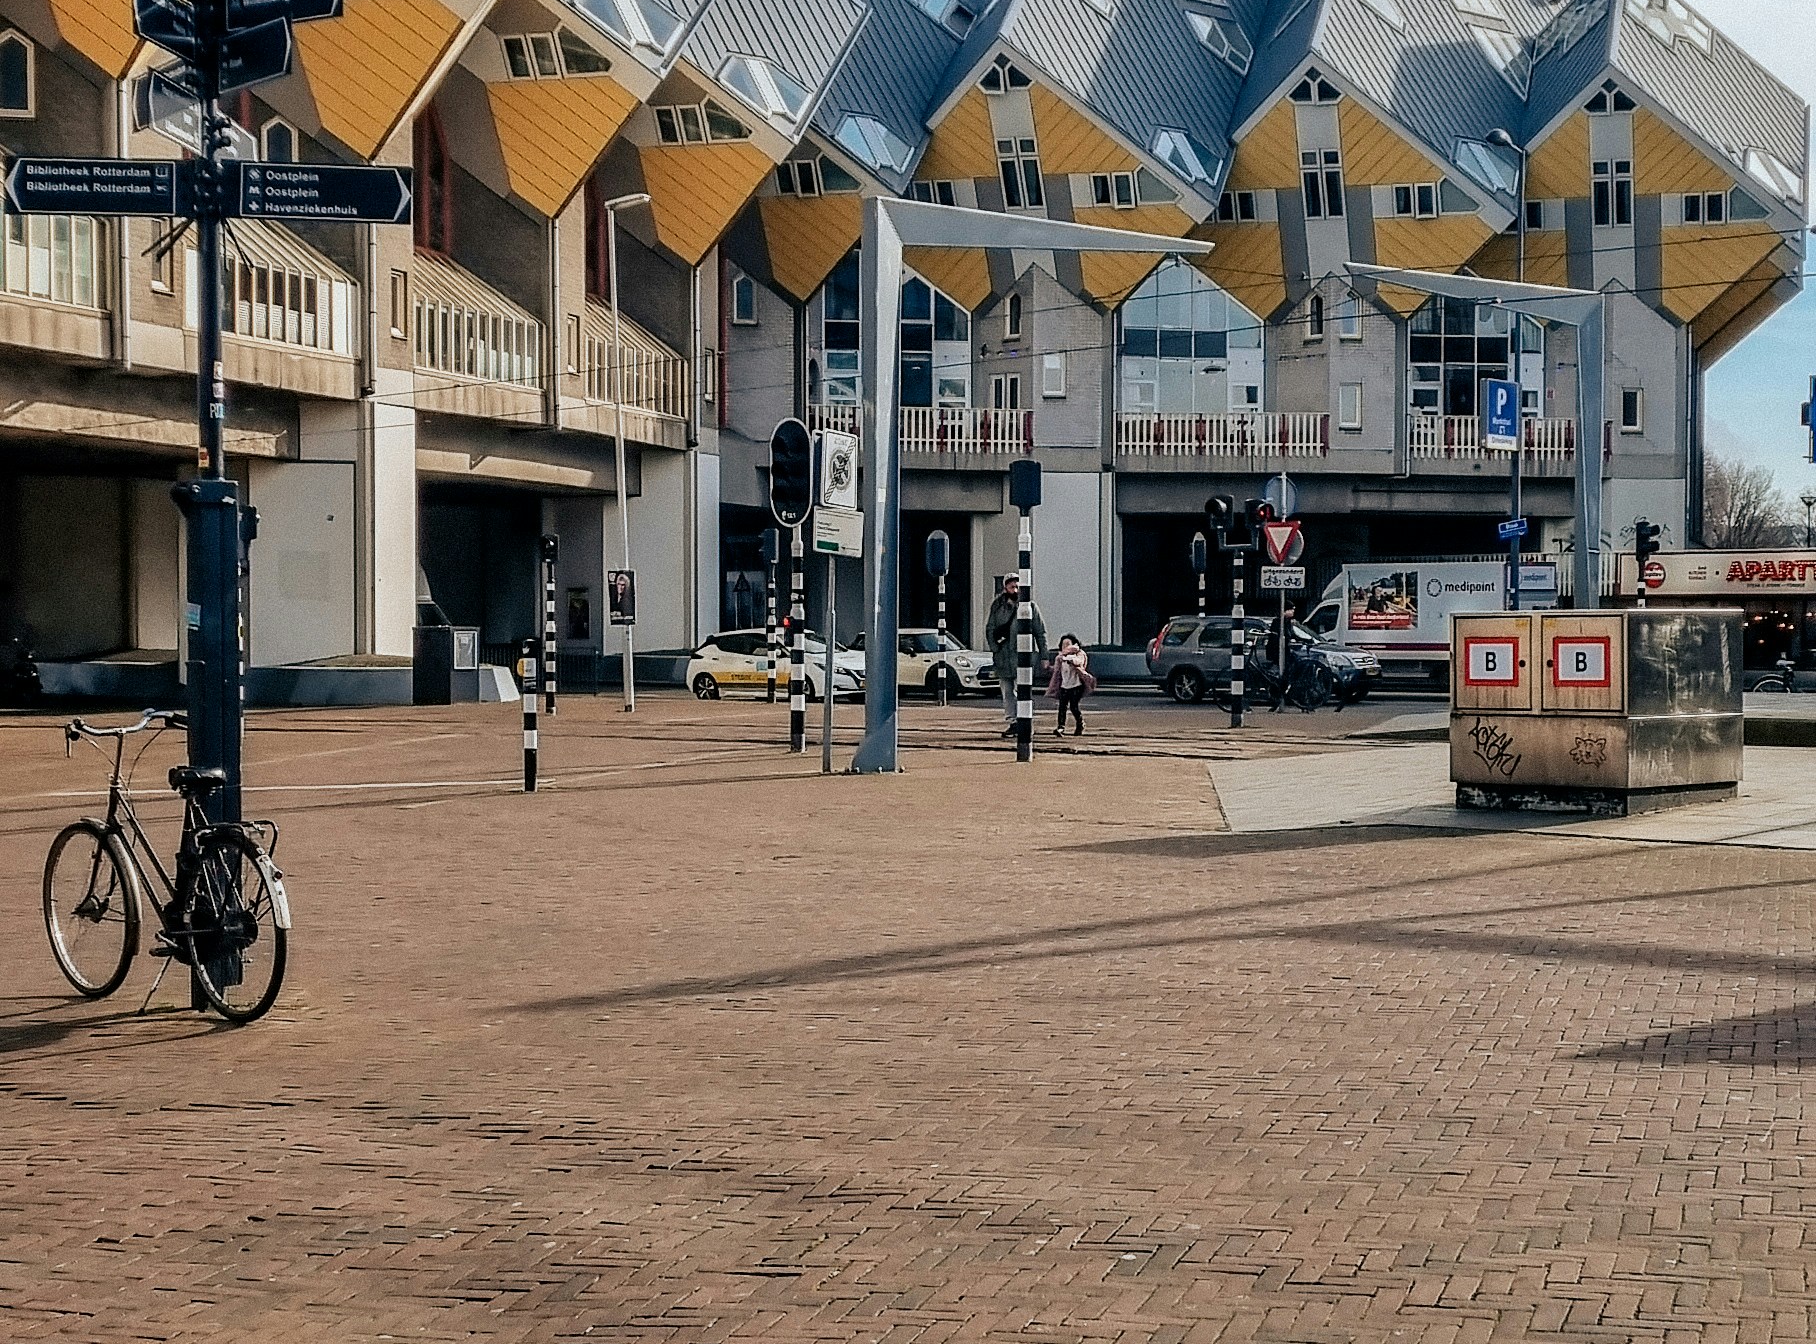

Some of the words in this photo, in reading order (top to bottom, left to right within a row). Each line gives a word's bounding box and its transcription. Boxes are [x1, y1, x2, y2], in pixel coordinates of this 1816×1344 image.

[26, 165, 89, 176] Bibliotheek
[93, 167, 150, 178] Rotterdam
[266, 170, 319, 184] Oostplein
[26, 181, 89, 192] Bibliotheek
[93, 183, 150, 194] Rotterdam
[265, 186, 319, 198] Oostplein
[265, 202, 358, 215] Havenziekenhuis
[1497, 387, 1508, 415] P
[1444, 580, 1495, 594] medipoint
[1485, 651, 1497, 672] B
[1575, 651, 1587, 672] B
